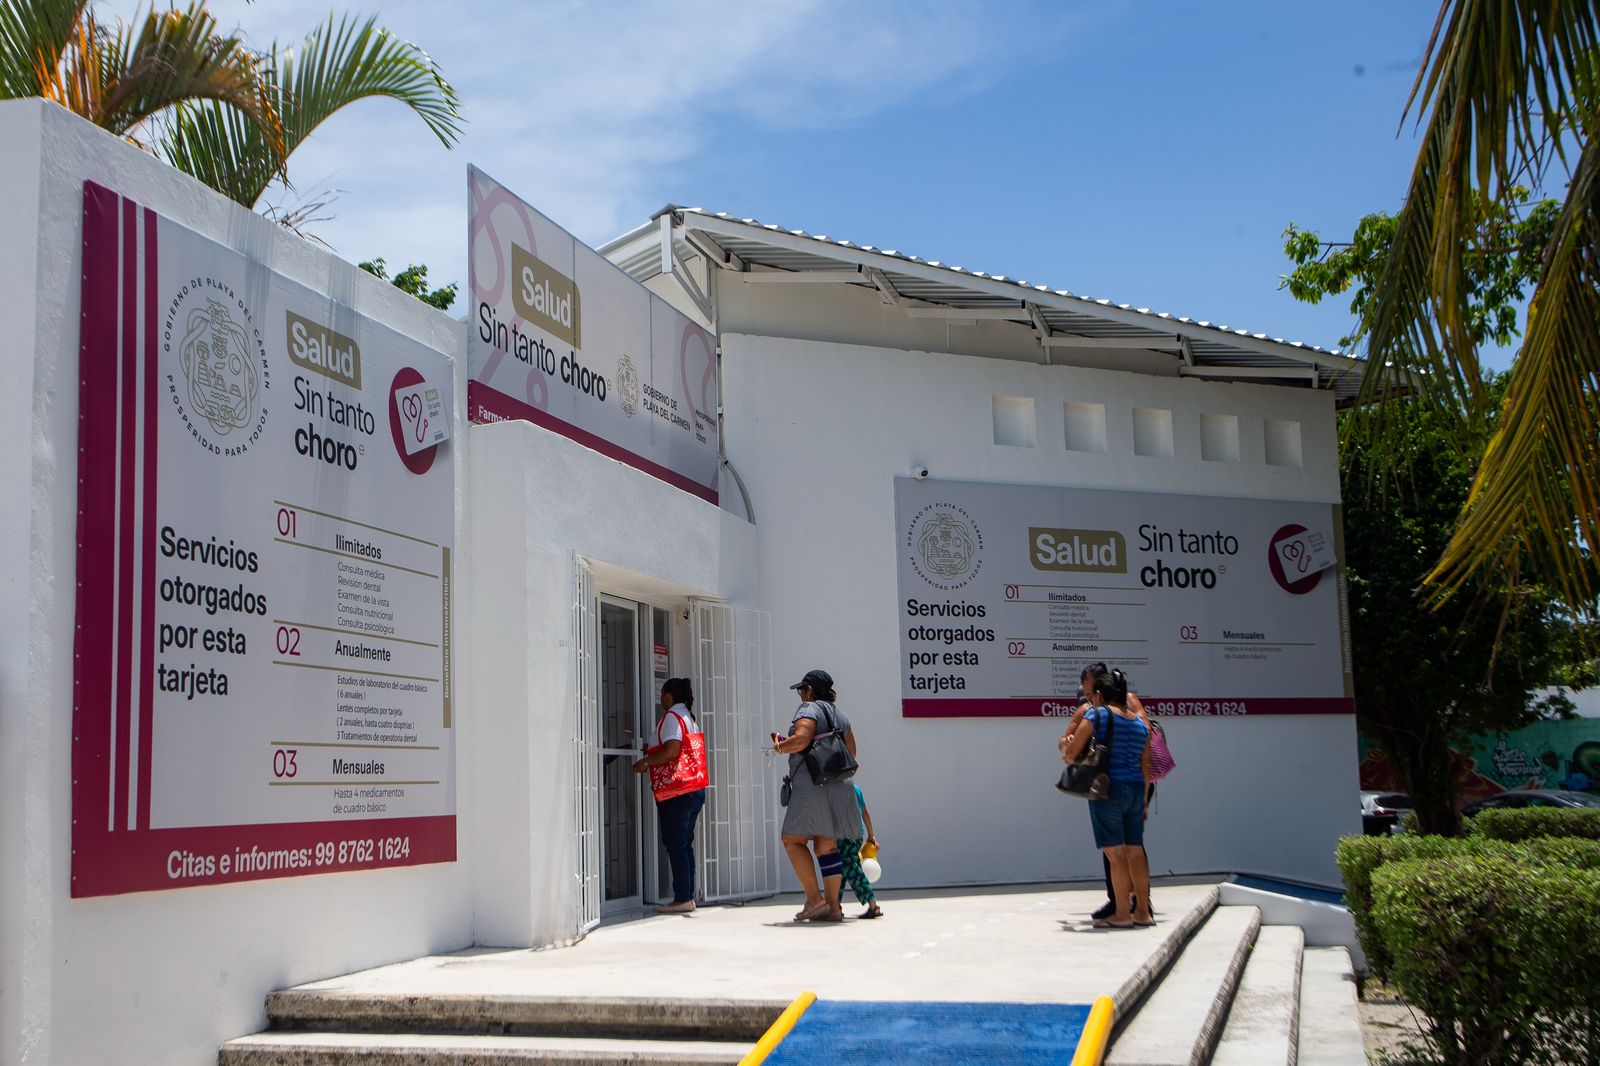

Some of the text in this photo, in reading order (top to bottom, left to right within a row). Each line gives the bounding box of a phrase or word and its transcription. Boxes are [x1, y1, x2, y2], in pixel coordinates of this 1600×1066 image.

[522, 265, 571, 328] Salud
[164, 277, 270, 389] GOBIERNO DE PLAYA DEL CARMEN
[291, 321, 354, 379] Salud
[479, 301, 607, 401] Sin tanto choro
[294, 375, 375, 435] Sin tanto
[642, 383, 678, 410] GOBIERNO DE
[166, 374, 268, 457] PROSPERIDAD PARA TODOS
[643, 398, 691, 432] PLAYA DEL CARMEN
[294, 422, 358, 470] choro
[277, 508, 296, 538] 01
[160, 526, 258, 573] Servicios
[335, 534, 382, 559] Ilimitados
[1138, 524, 1239, 555] Sin tanto
[1036, 533, 1117, 567] Salud
[337, 562, 385, 580] Consulta médica
[1140, 559, 1217, 589] choro
[337, 575, 381, 592] Revisión dental
[1005, 585, 1019, 599] 01
[160, 576, 267, 616] otorgados
[337, 589, 390, 607] Examen de la vista
[1048, 593, 1087, 601] Ilimitados
[337, 602, 394, 620] Consulta nutricional
[907, 599, 986, 618] Servicios
[337, 616, 395, 635] Consulta psicológica
[908, 625, 995, 645] otorgados
[1180, 626, 1198, 640] 03
[1222, 630, 1265, 640] Mensuales
[159, 623, 246, 655] por esta
[276, 626, 301, 656] 02
[1008, 642, 1026, 656] 02
[1052, 643, 1099, 652] Anualmente
[335, 640, 391, 661] Anualmente
[909, 650, 979, 669] por esta
[157, 663, 228, 701] tarjeta
[337, 675, 358, 686] Estudios
[359, 679, 365, 687] de
[366, 678, 391, 689] laboratorio
[399, 682, 414, 691] cuadro
[414, 683, 428, 692] básico
[909, 673, 966, 694] tarjeta
[344, 690, 363, 700] anuales
[336, 703, 354, 713] Lentes
[354, 705, 379, 715] completos
[388, 707, 402, 717] tarjeta
[1041, 702, 1077, 717] Citas
[1157, 702, 1175, 716] 99
[1177, 702, 1212, 716] 8762
[1214, 702, 1247, 716] 1624
[364, 719, 377, 728] hasta
[378, 720, 392, 729] cuatro
[336, 731, 417, 743] 3 Tratamientos de operatoria dental
[273, 749, 297, 777] 03
[332, 759, 385, 775] Mensuales
[334, 788, 404, 798] Hasta 4 medicamentos
[333, 802, 386, 814] de cuadro básico
[167, 836, 410, 879] Citas e informes: 99 8762 1624
